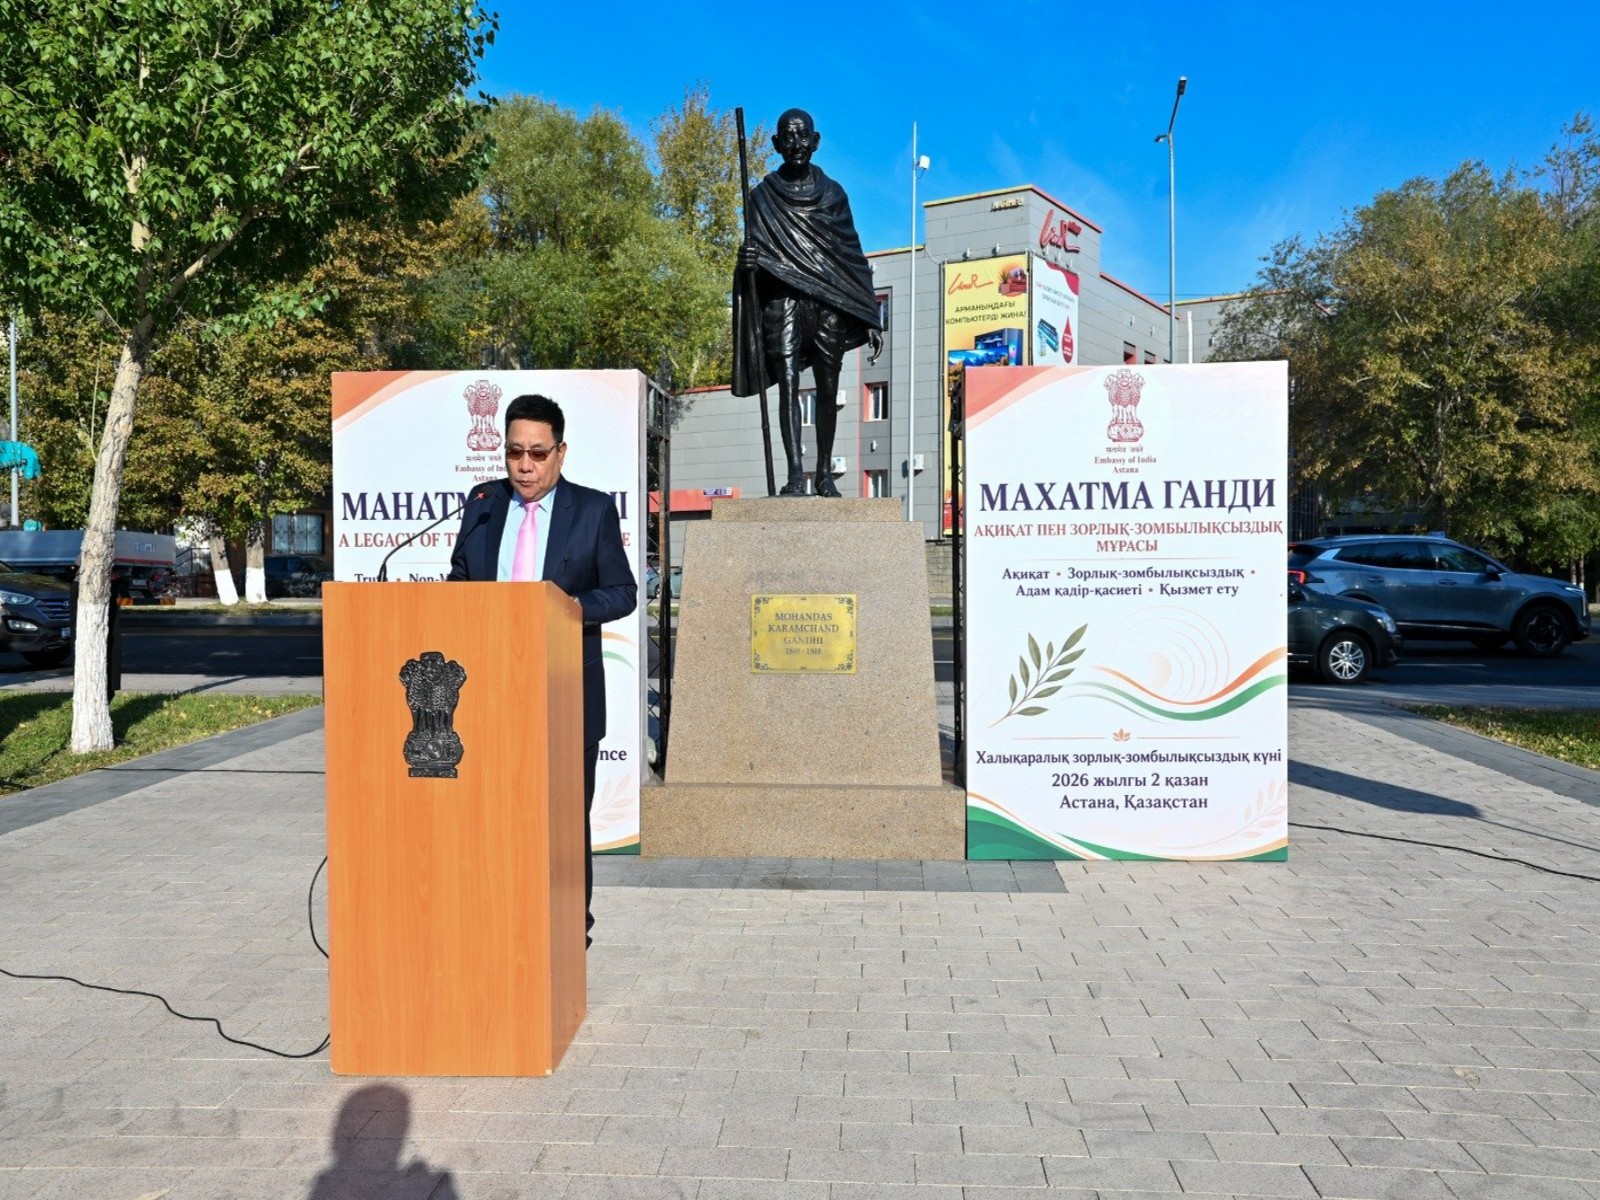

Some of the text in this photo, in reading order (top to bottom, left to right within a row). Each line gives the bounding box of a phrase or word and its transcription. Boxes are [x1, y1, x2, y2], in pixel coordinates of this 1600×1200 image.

[955, 300, 1016, 314] АРМАНЫҢДАҒЫ
[1094, 456, 1126, 465] Embassy
[455, 465, 485, 474] Embassy
[1113, 466, 1139, 474] Astana
[979, 478, 1276, 514] МАХАТМА ГАНДИ
[974, 521, 1284, 538] АҚИҚАТ ПЕН ЗОРЛЫҚ-ЗОМБЫЛЫҚСЫЗДЫҚ
[339, 532, 350, 547] A
[354, 532, 415, 547] LEGACY
[420, 532, 441, 547] OF
[1096, 539, 1158, 553] МҰРАСЫ
[1002, 566, 1245, 580] Ақиқат Зорлық-зомбылықсыздық
[1015, 583, 1240, 598] Адам қадір-қасиеті Қызмет ету
[775, 612, 833, 621] MOHANDAS
[768, 624, 839, 633] KARAMCHAND
[783, 636, 823, 645] GANDHI
[976, 748, 1282, 767] Халықаралық зорлық-зомбылықсыздық күні
[1051, 772, 1090, 787] 2026
[1150, 772, 1161, 787] 2
[1164, 776, 1209, 789] қазан
[1059, 794, 1208, 811] Астана, Қазақстан
